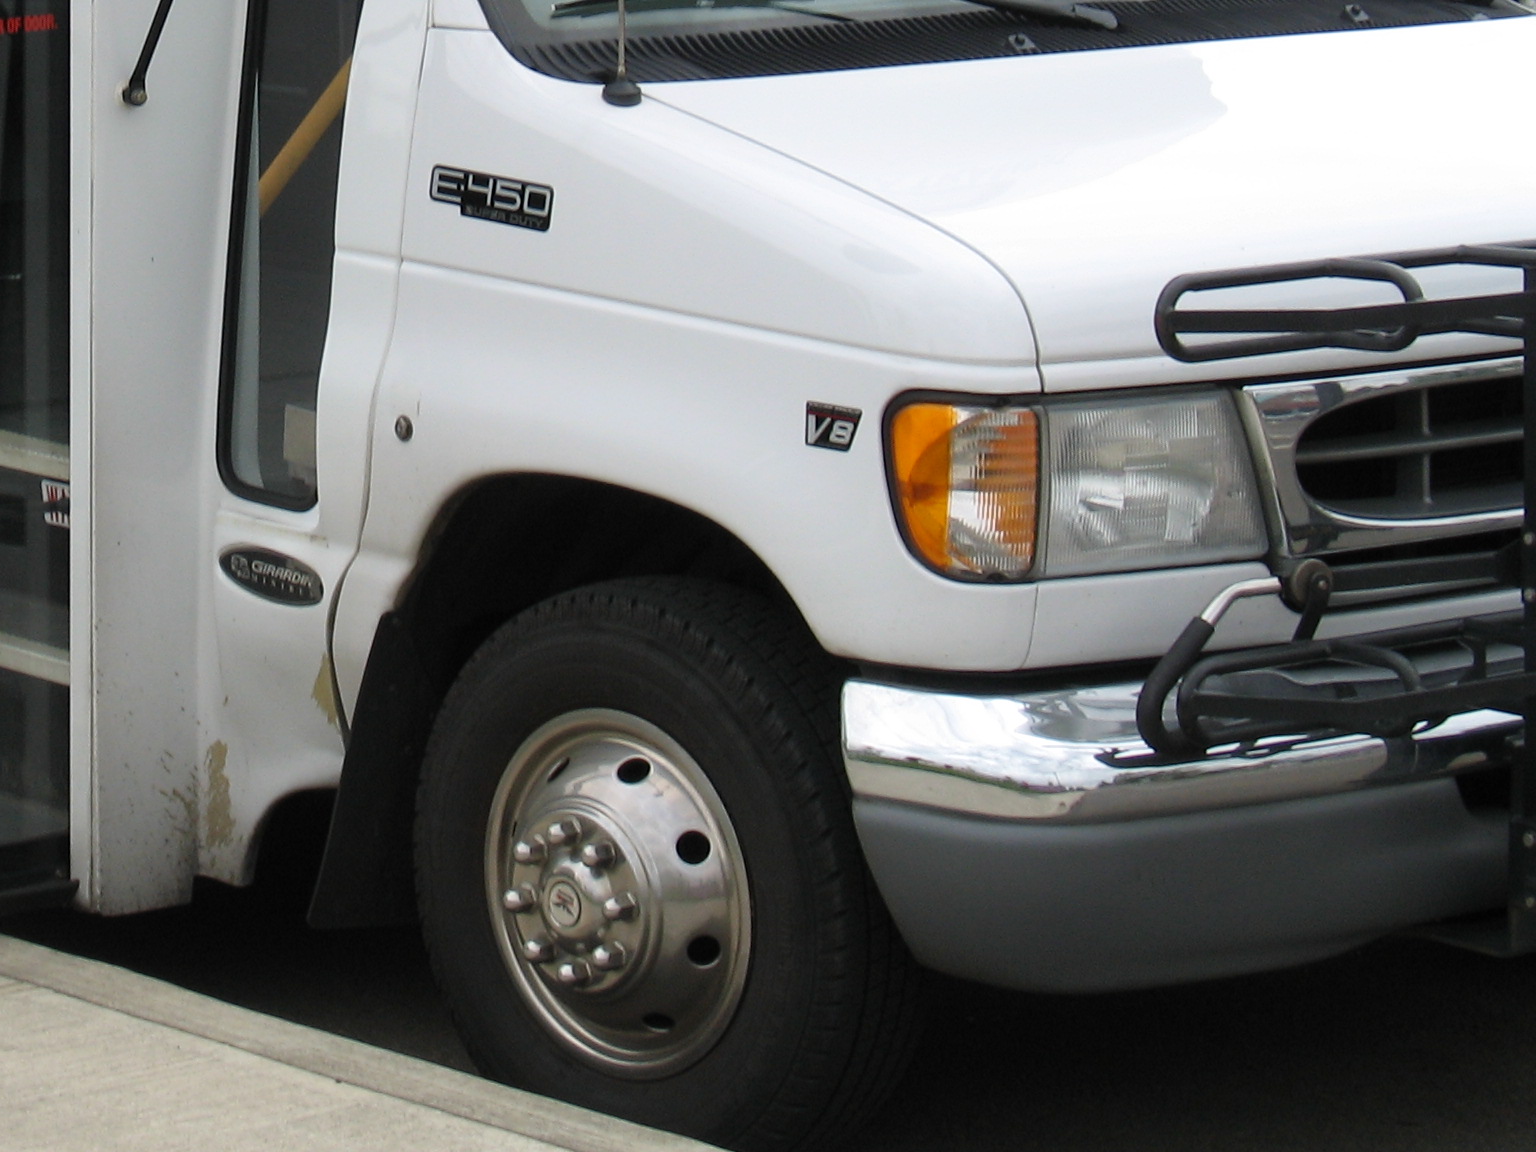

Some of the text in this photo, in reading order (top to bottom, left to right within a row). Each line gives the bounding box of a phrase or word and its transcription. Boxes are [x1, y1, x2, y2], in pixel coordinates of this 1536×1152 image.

[7, 16, 23, 34] OF
[807, 413, 855, 445] V8
[251, 559, 313, 587] GIRARDIN
